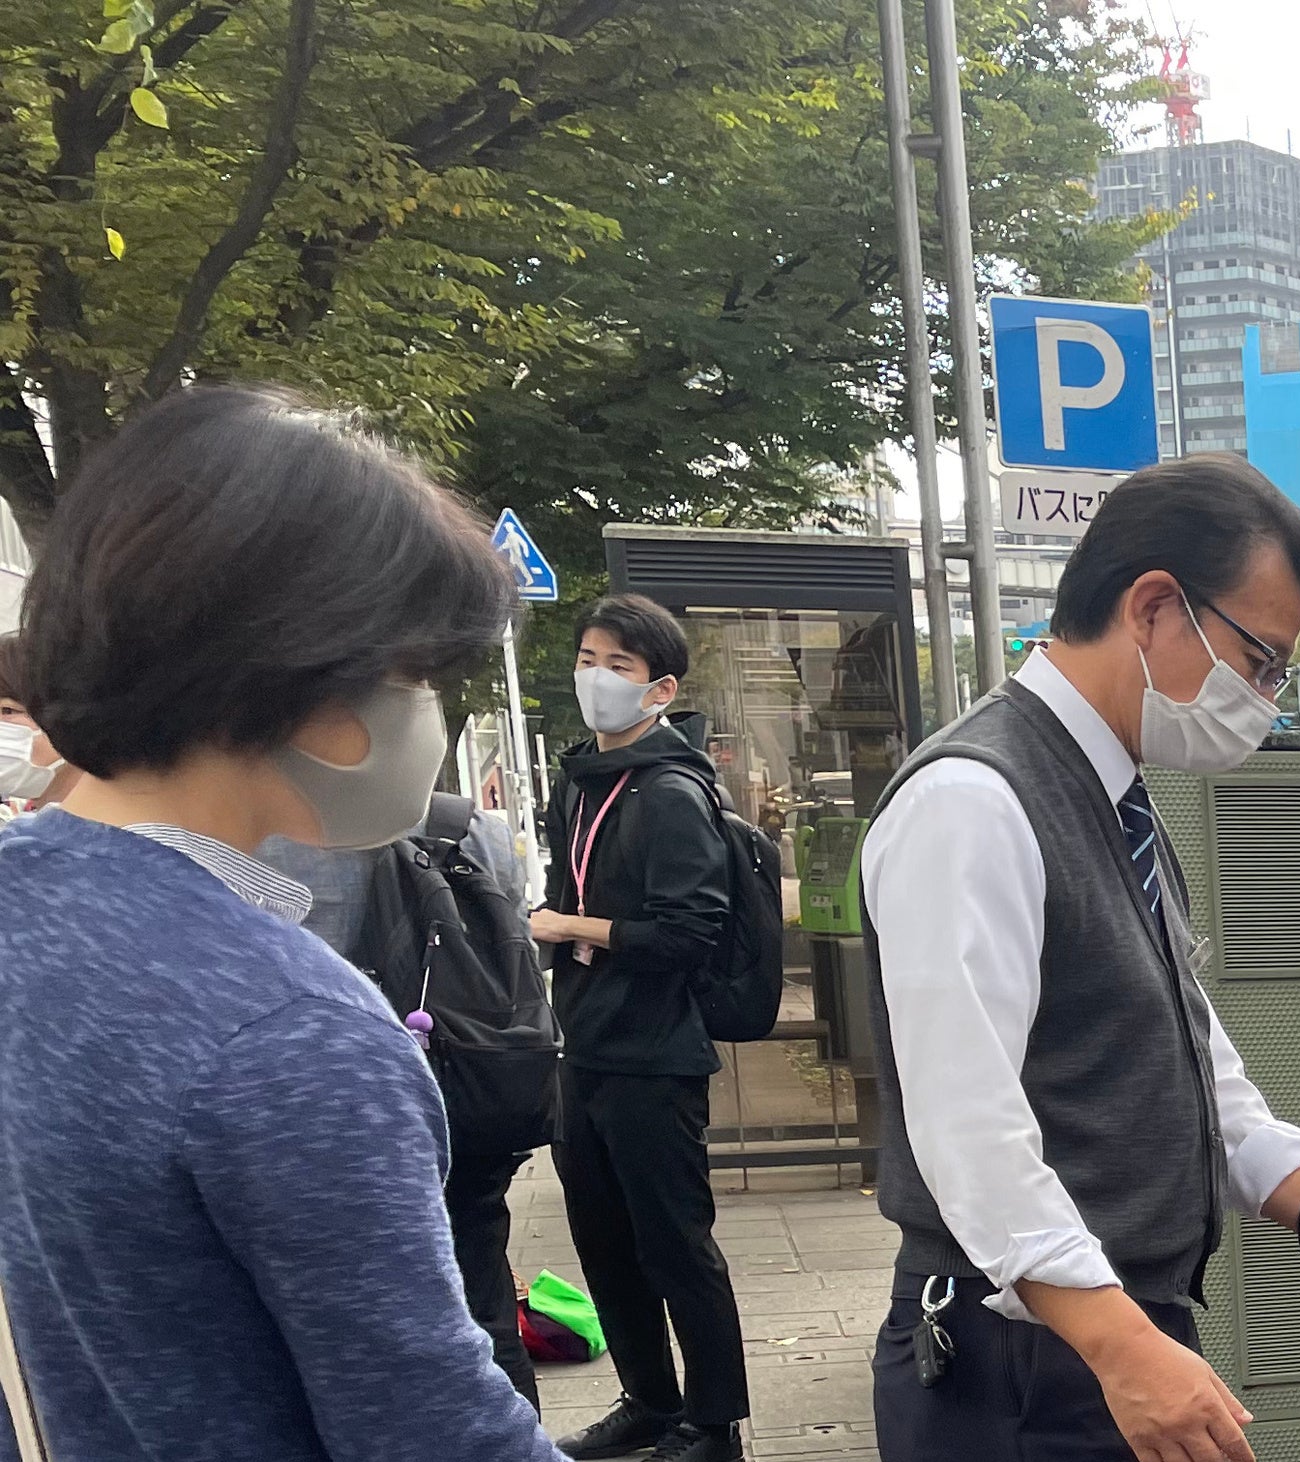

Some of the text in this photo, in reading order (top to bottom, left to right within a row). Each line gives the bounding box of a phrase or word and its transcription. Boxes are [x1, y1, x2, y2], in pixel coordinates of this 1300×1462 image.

[1035, 317, 1126, 451] P
[1016, 486, 1108, 523] バスに
